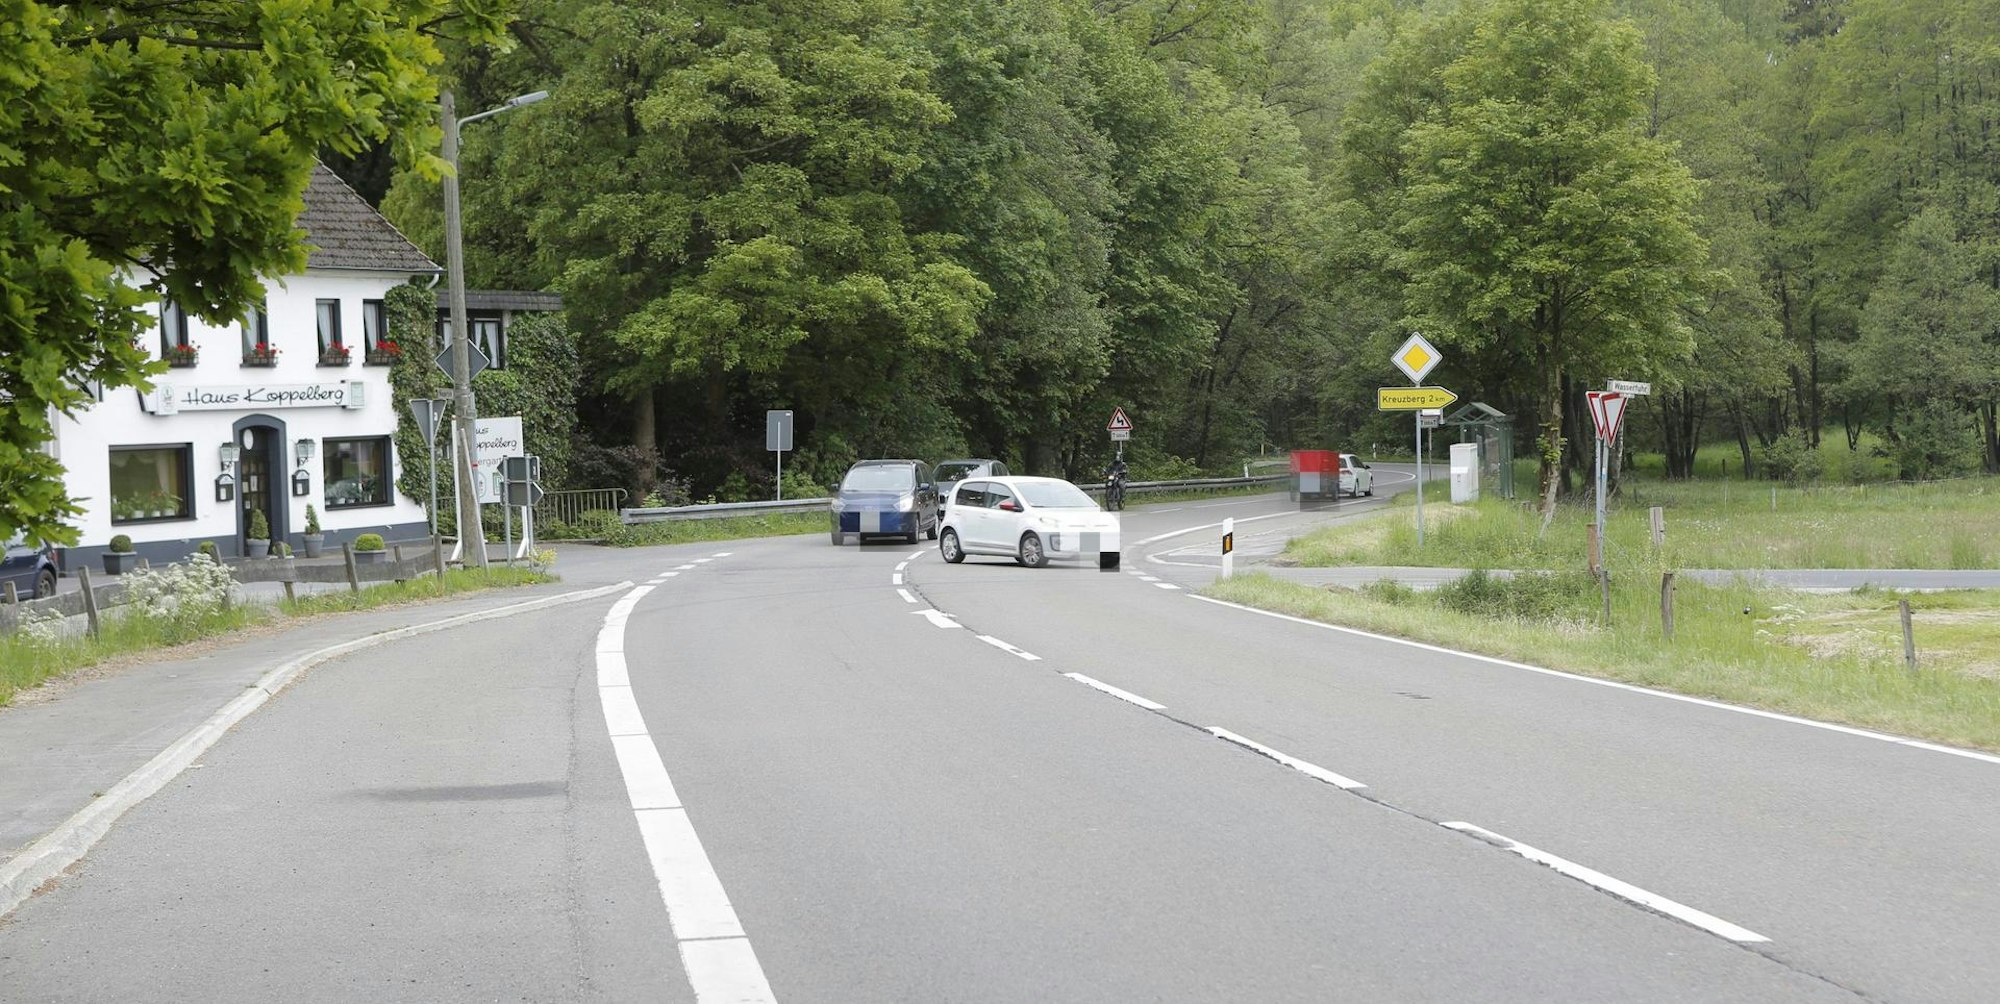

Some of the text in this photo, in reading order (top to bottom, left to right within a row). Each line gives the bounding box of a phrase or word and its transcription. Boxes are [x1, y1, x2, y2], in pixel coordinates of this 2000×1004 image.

[181, 387, 239, 405] Haus
[244, 385, 344, 405] Koppelberg
[1382, 395, 1426, 404] Kreuzberg
[1428, 394, 1434, 402] 2
[475, 427, 489, 435] us
[476, 437, 517, 451] oppelberg
